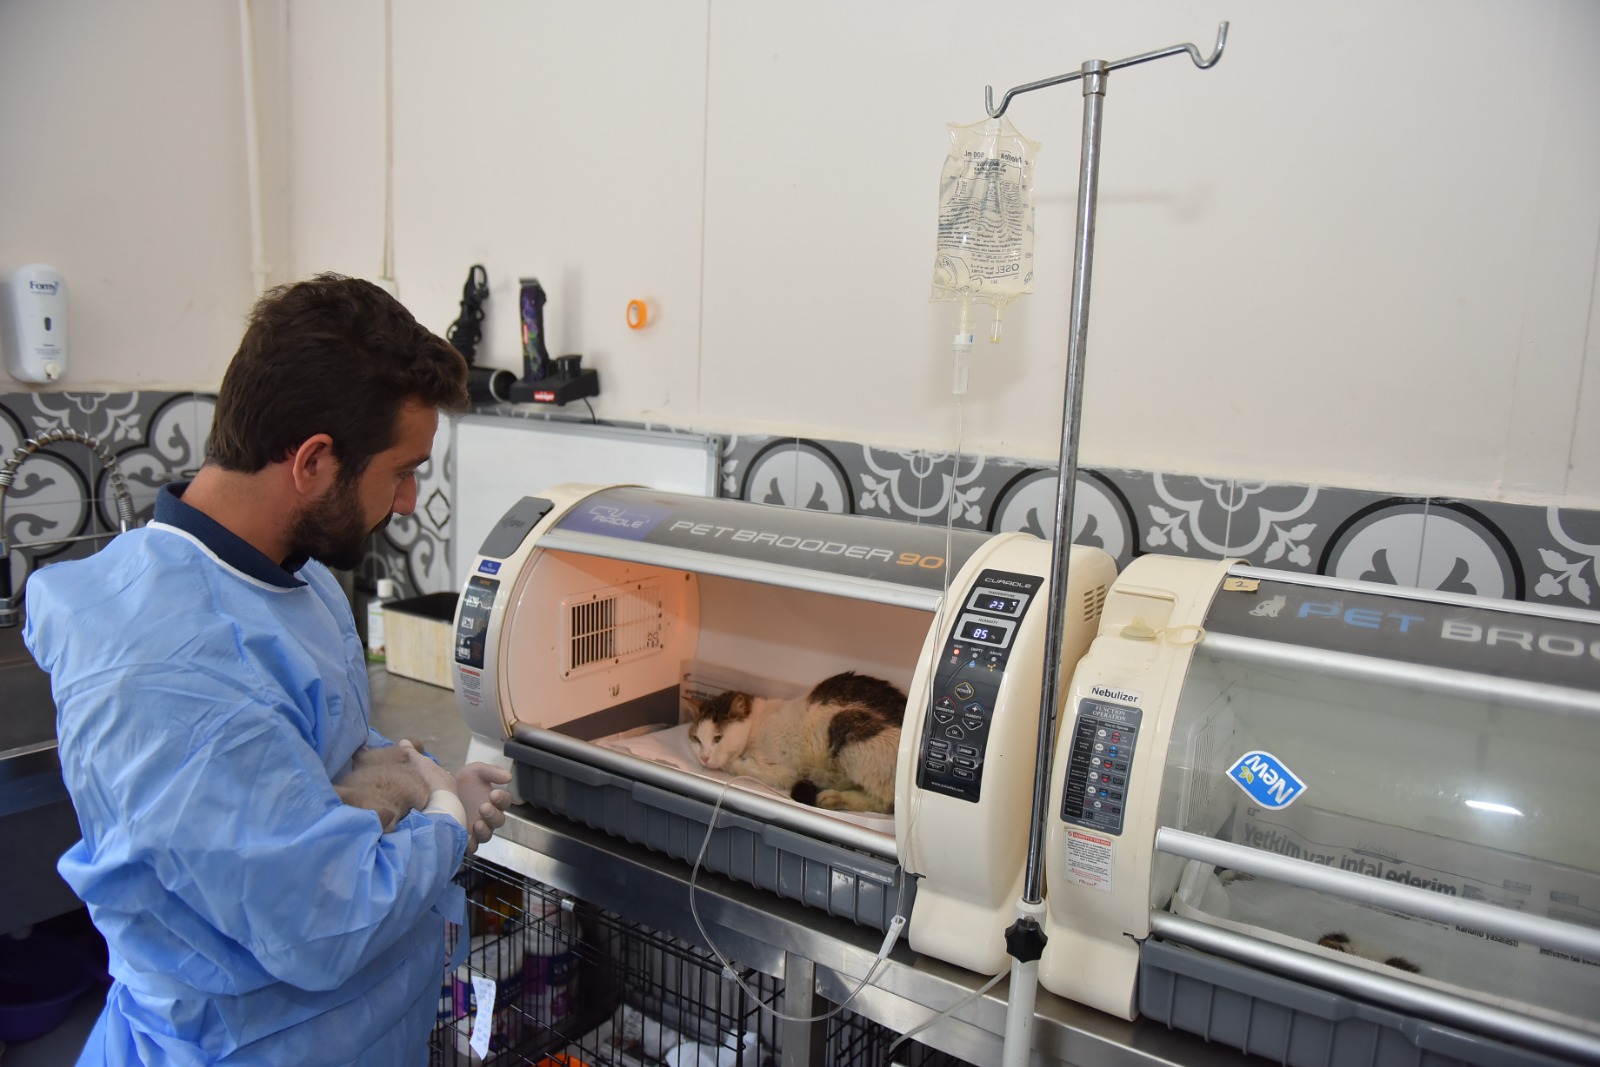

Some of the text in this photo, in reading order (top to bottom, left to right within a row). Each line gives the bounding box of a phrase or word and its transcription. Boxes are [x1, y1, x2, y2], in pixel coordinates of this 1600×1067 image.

[668, 520, 945, 570] PET BROODER 90
[989, 600, 1006, 610] 23
[973, 628, 989, 640] 85
[1297, 601, 1600, 658] PET BRO
[1091, 686, 1139, 703] Nebulizer
[1092, 710, 1127, 722] OPERATION
[1095, 705, 1126, 716] FUNCTION
[1244, 755, 1295, 804] New
[1243, 821, 1301, 857] Yetkim
